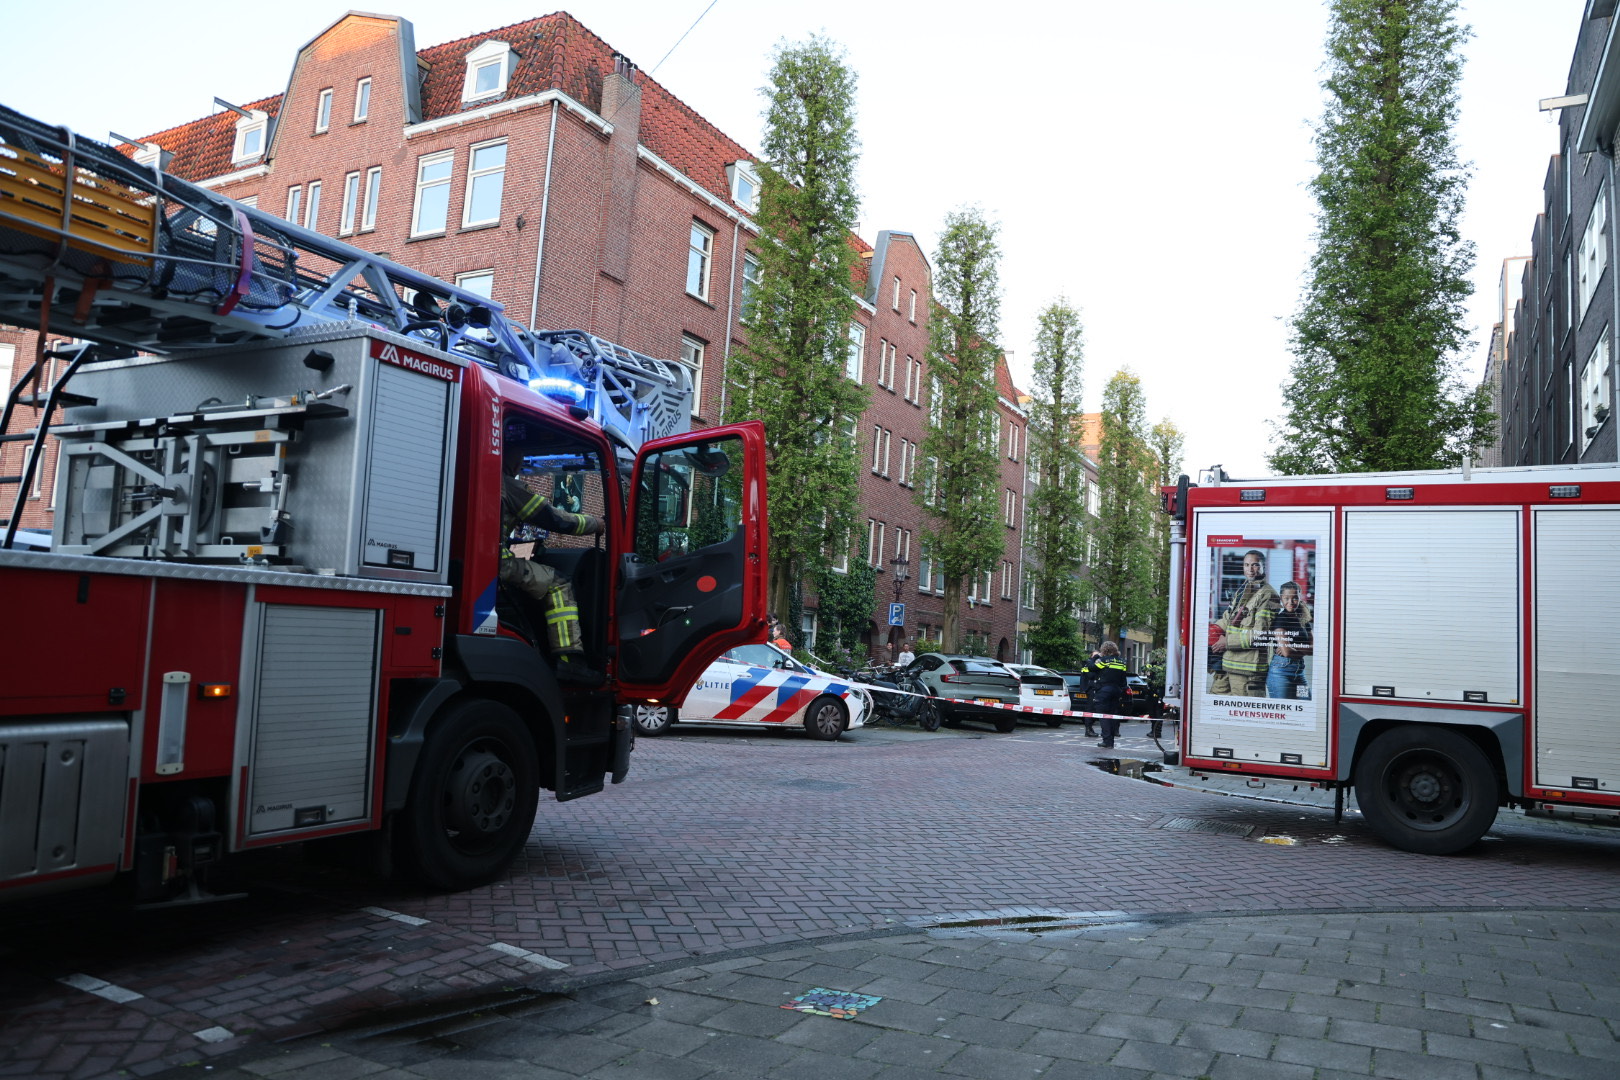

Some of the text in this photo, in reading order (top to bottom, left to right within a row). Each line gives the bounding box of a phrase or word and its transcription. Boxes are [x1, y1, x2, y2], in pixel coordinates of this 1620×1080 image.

[403, 354, 454, 380] MAGIRUS
[492, 396, 500, 456] 13-3551
[657, 409, 682, 439] GIRUS
[893, 606, 902, 617] P
[697, 681, 730, 690] OLITIE
[1213, 700, 1292, 711] BRANDWEERWERK
[1228, 710, 1286, 719] LEVENSWERK
